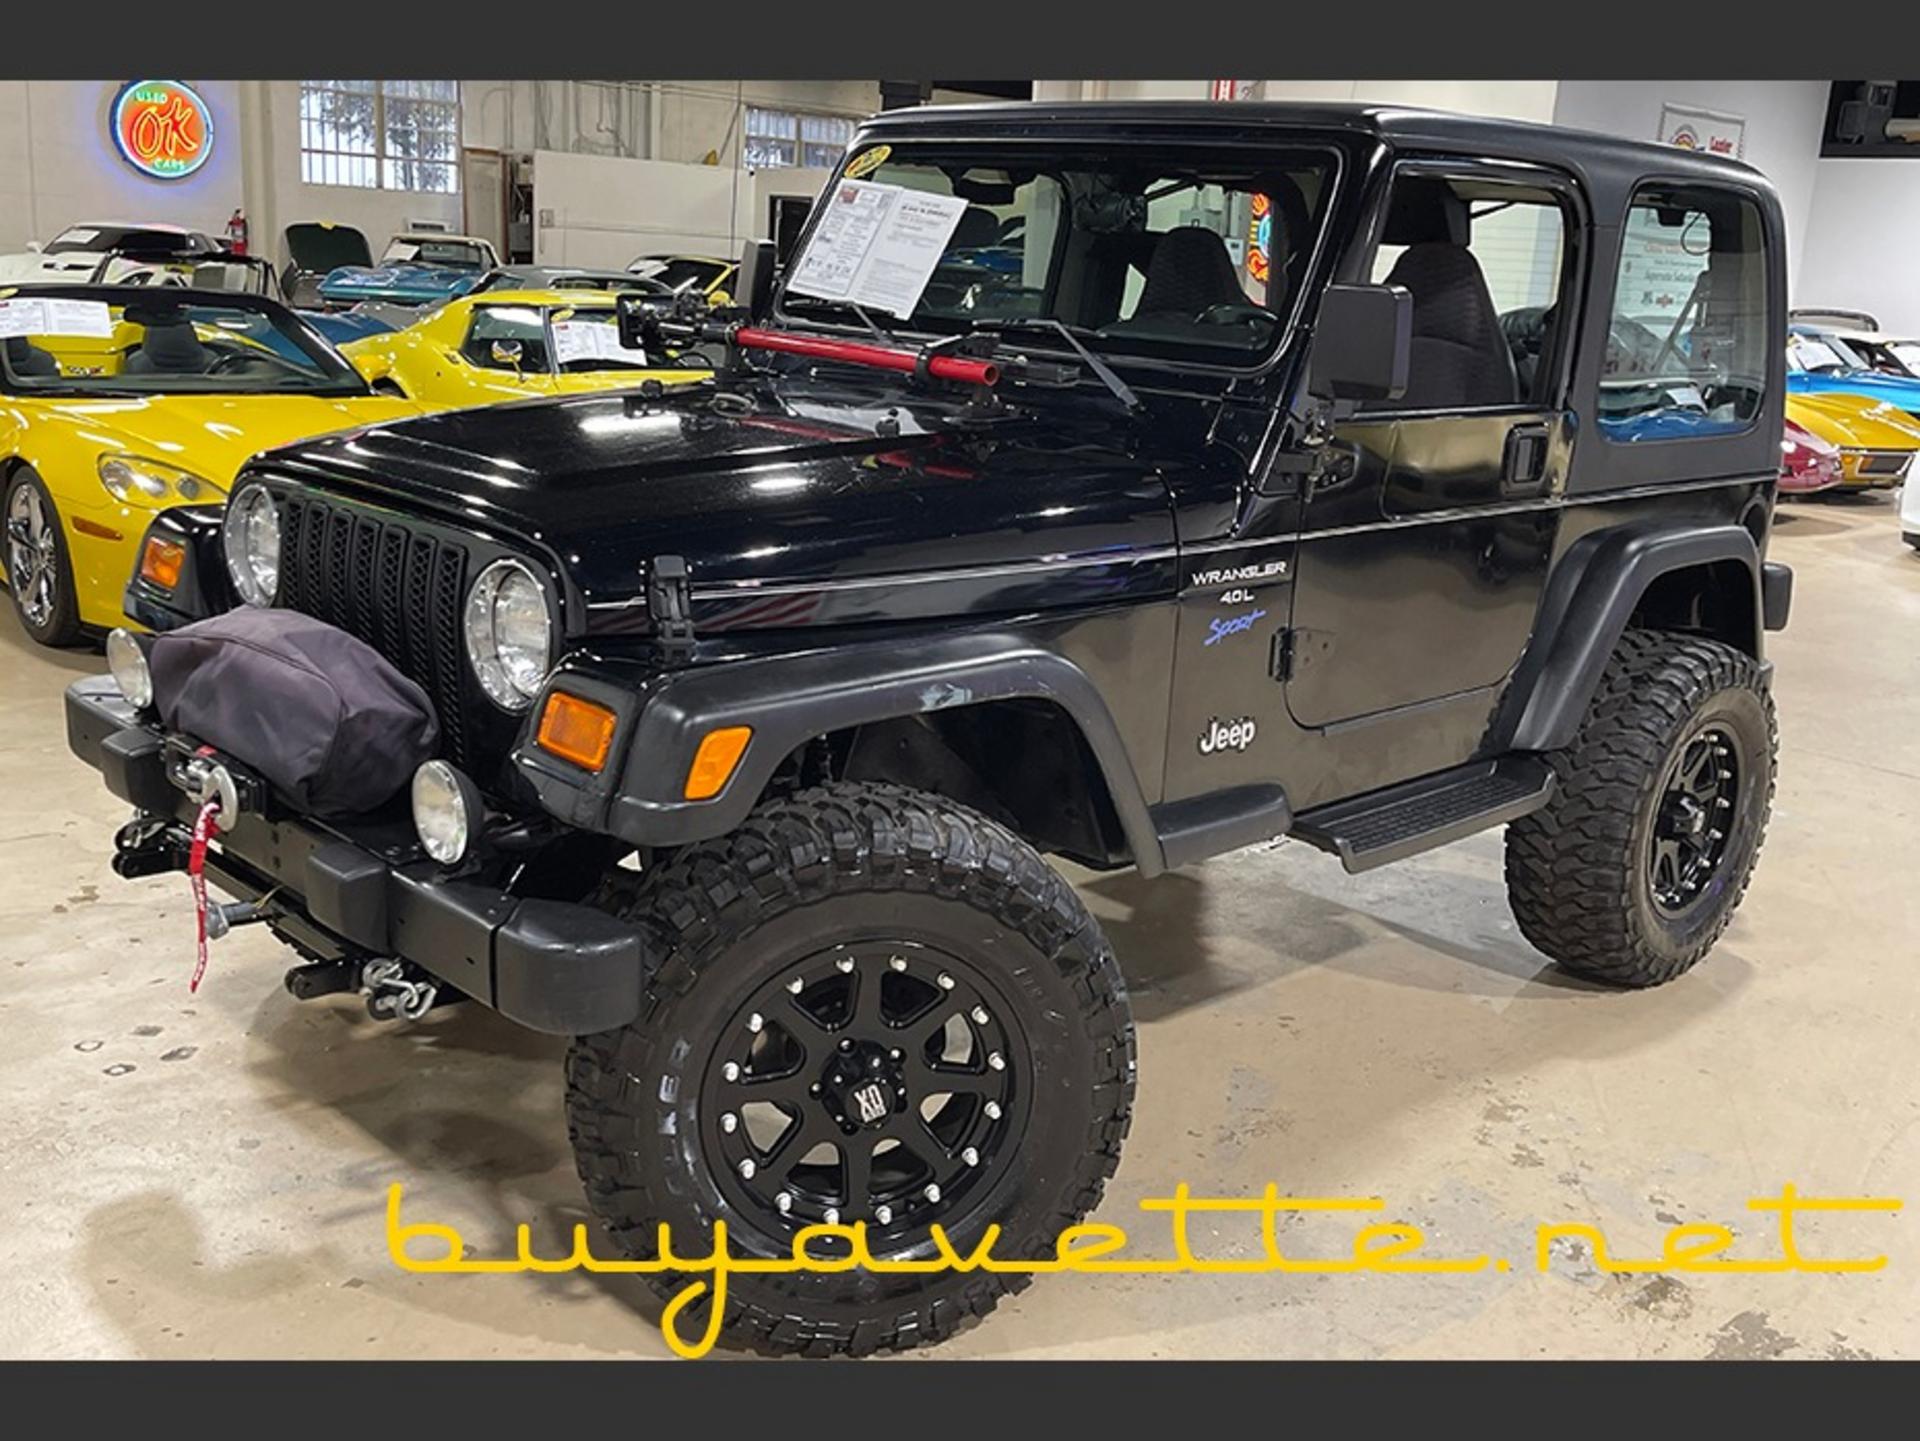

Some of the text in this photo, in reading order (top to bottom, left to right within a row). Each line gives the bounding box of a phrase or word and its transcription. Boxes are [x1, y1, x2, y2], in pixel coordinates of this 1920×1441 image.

[132, 97, 198, 157] OK
[1192, 560, 1288, 586] WRANGLER
[1203, 607, 1266, 646] Sport
[1199, 720, 1256, 753] Jeep
